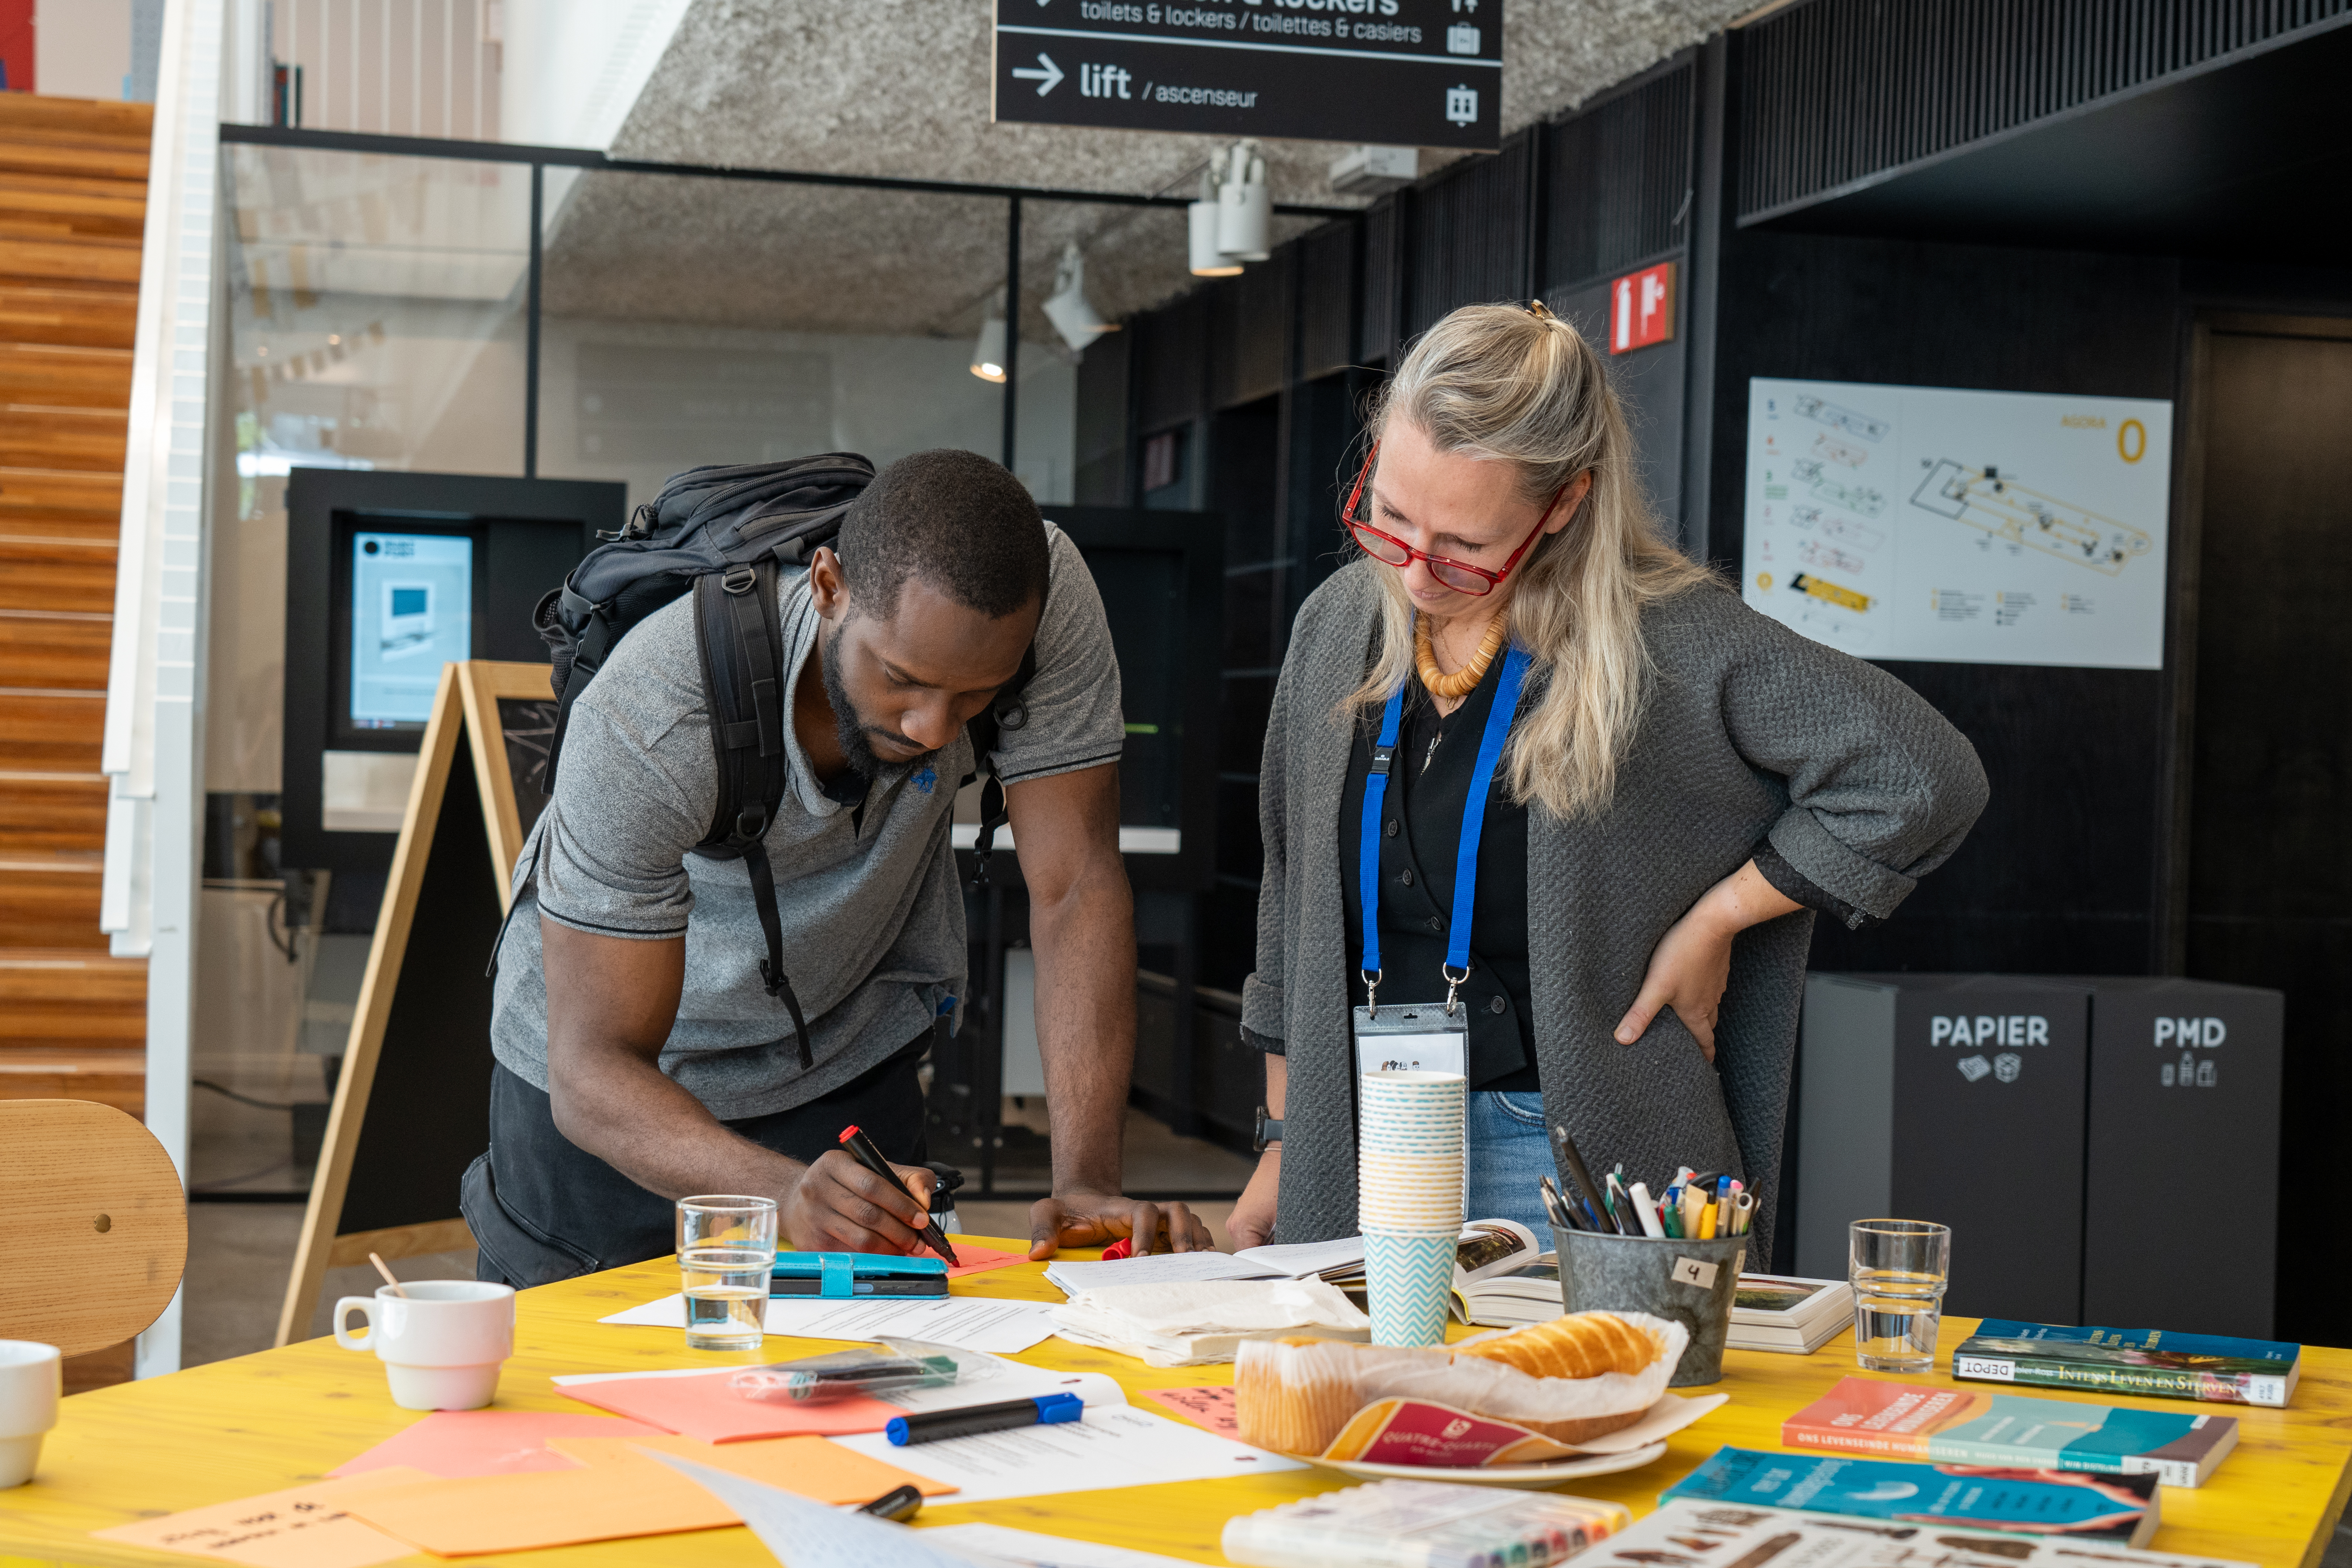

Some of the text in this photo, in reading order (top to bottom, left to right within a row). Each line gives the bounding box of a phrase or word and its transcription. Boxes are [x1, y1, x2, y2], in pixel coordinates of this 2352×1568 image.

[1080, 0, 1422, 43] toilets & lockers / toilettes & casiers
[1080, 62, 1258, 108] lift / ascenseur
[1931, 1016, 2049, 1046] PAPIER
[2154, 1017, 2226, 1048] PMD
[1688, 1264, 1700, 1281] 4
[1964, 1361, 2009, 1376] DEPOT
[2058, 1365, 2236, 1394] INTENS LEVEN EN STERVEN
[1797, 1432, 1819, 1444] ONS
[1821, 1435, 1889, 1451] LEVENSEINDE
[1892, 1441, 1968, 1458] HUMANISEREN
